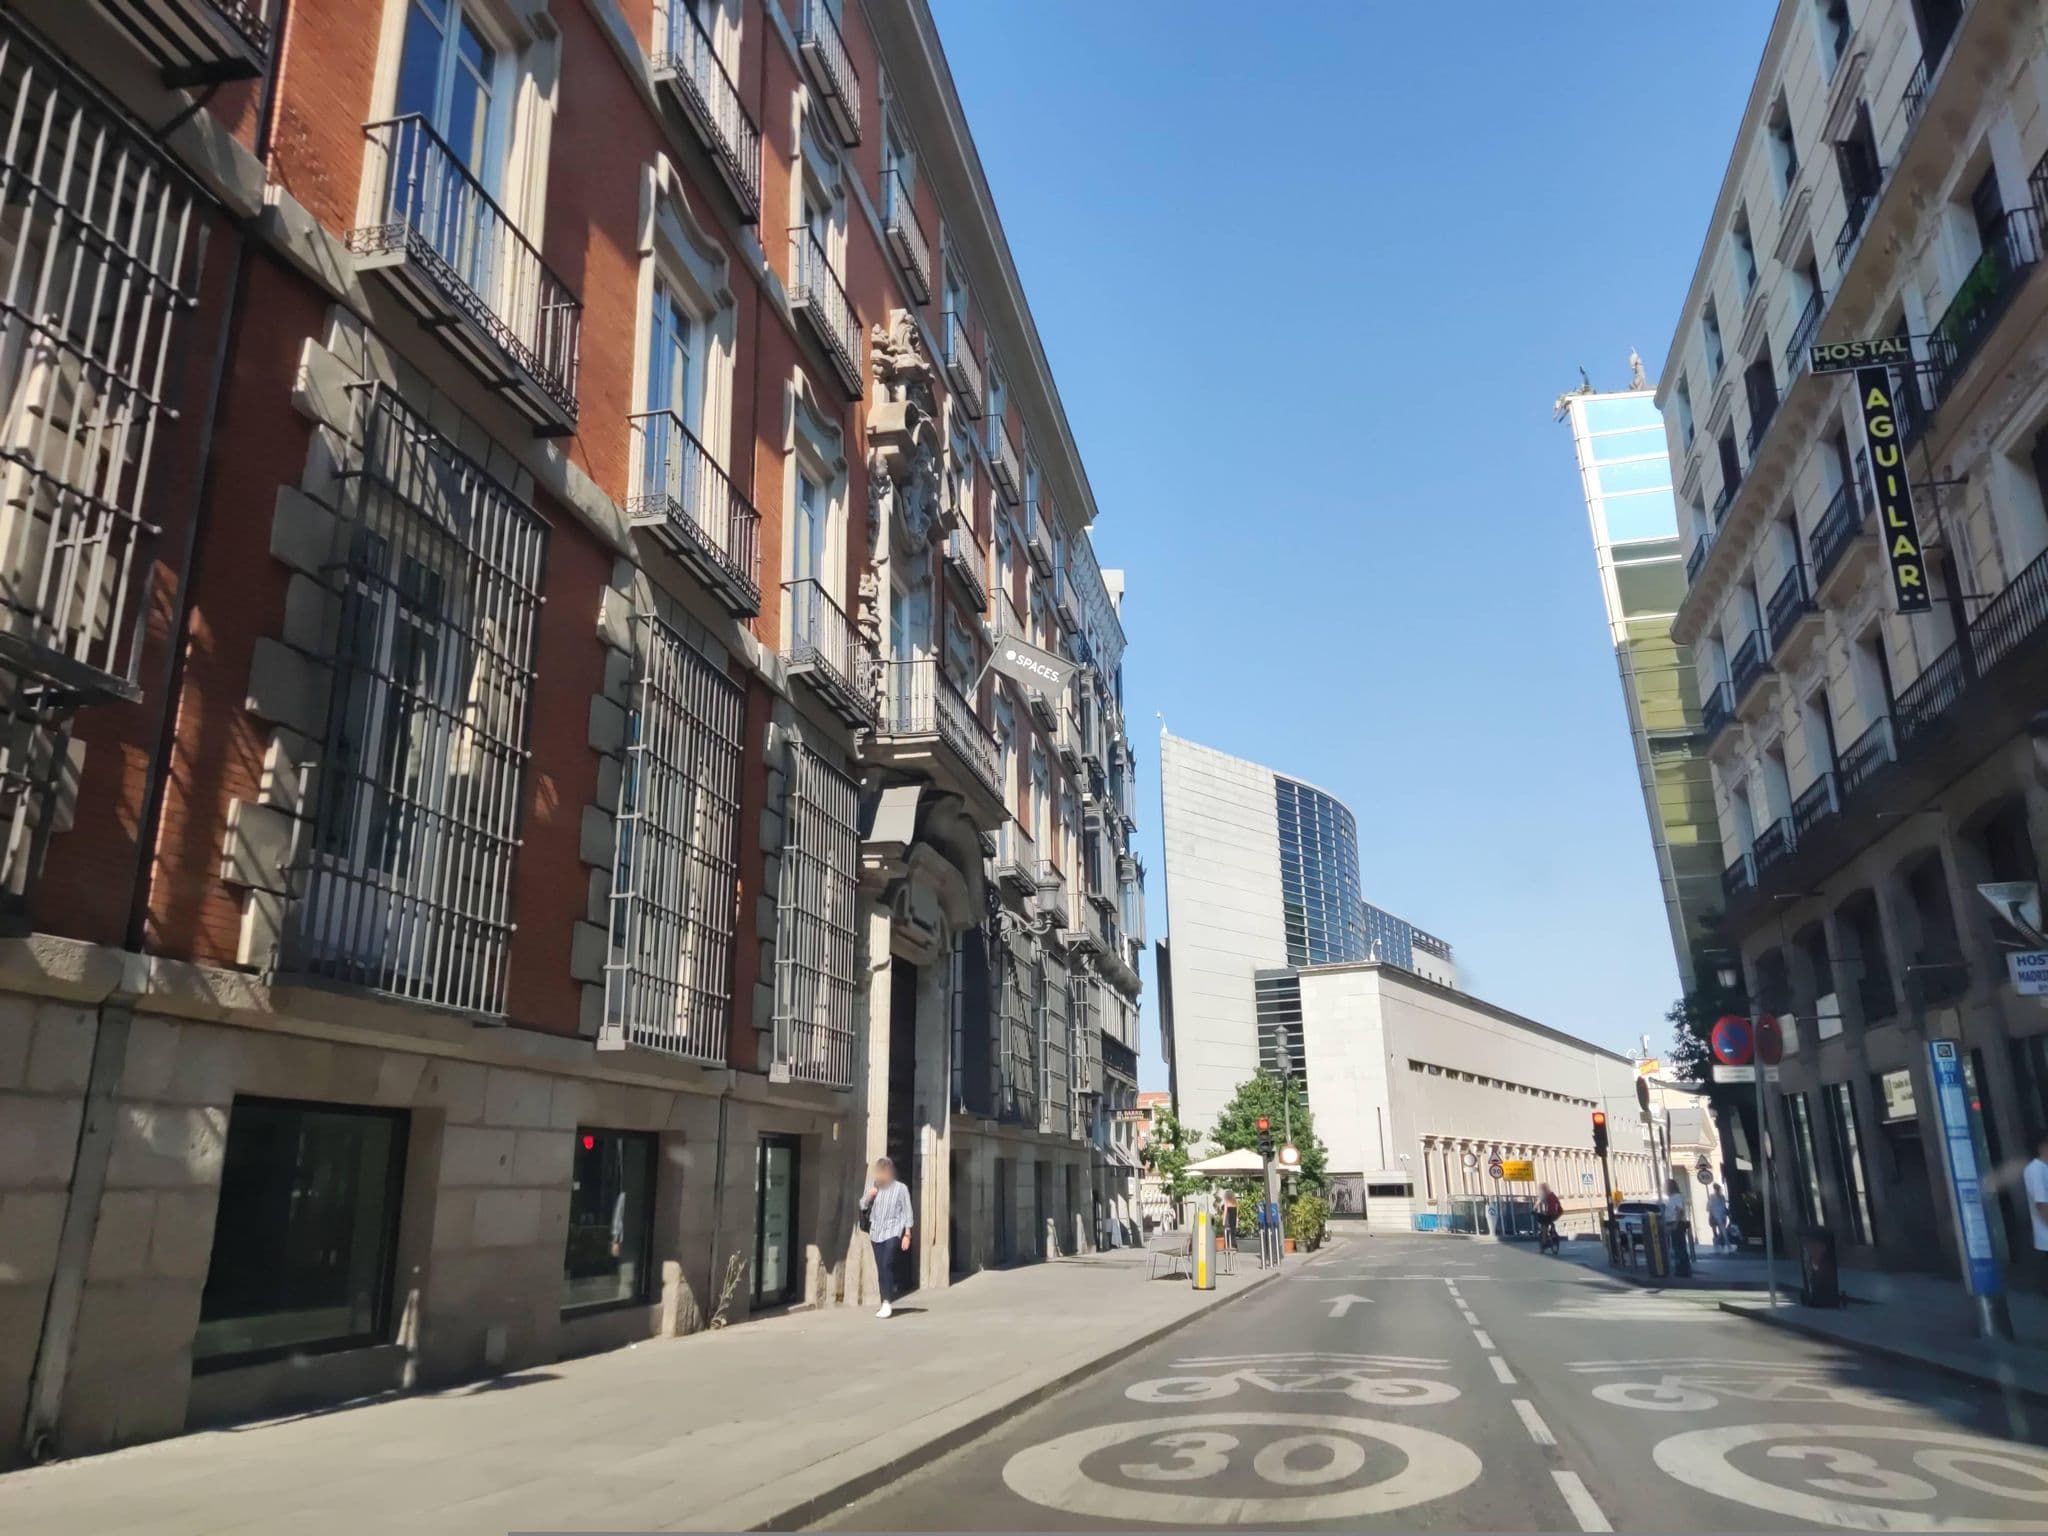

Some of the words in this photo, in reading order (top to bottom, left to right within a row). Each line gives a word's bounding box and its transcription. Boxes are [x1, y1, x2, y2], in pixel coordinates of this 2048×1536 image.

[1813, 339, 1908, 362] HOSTAL
[1866, 387, 1921, 588] AGUILAR
[2016, 954, 2048, 967] HOS
[1119, 1432, 1365, 1485] 30
[1767, 1445, 2048, 1504] 30
